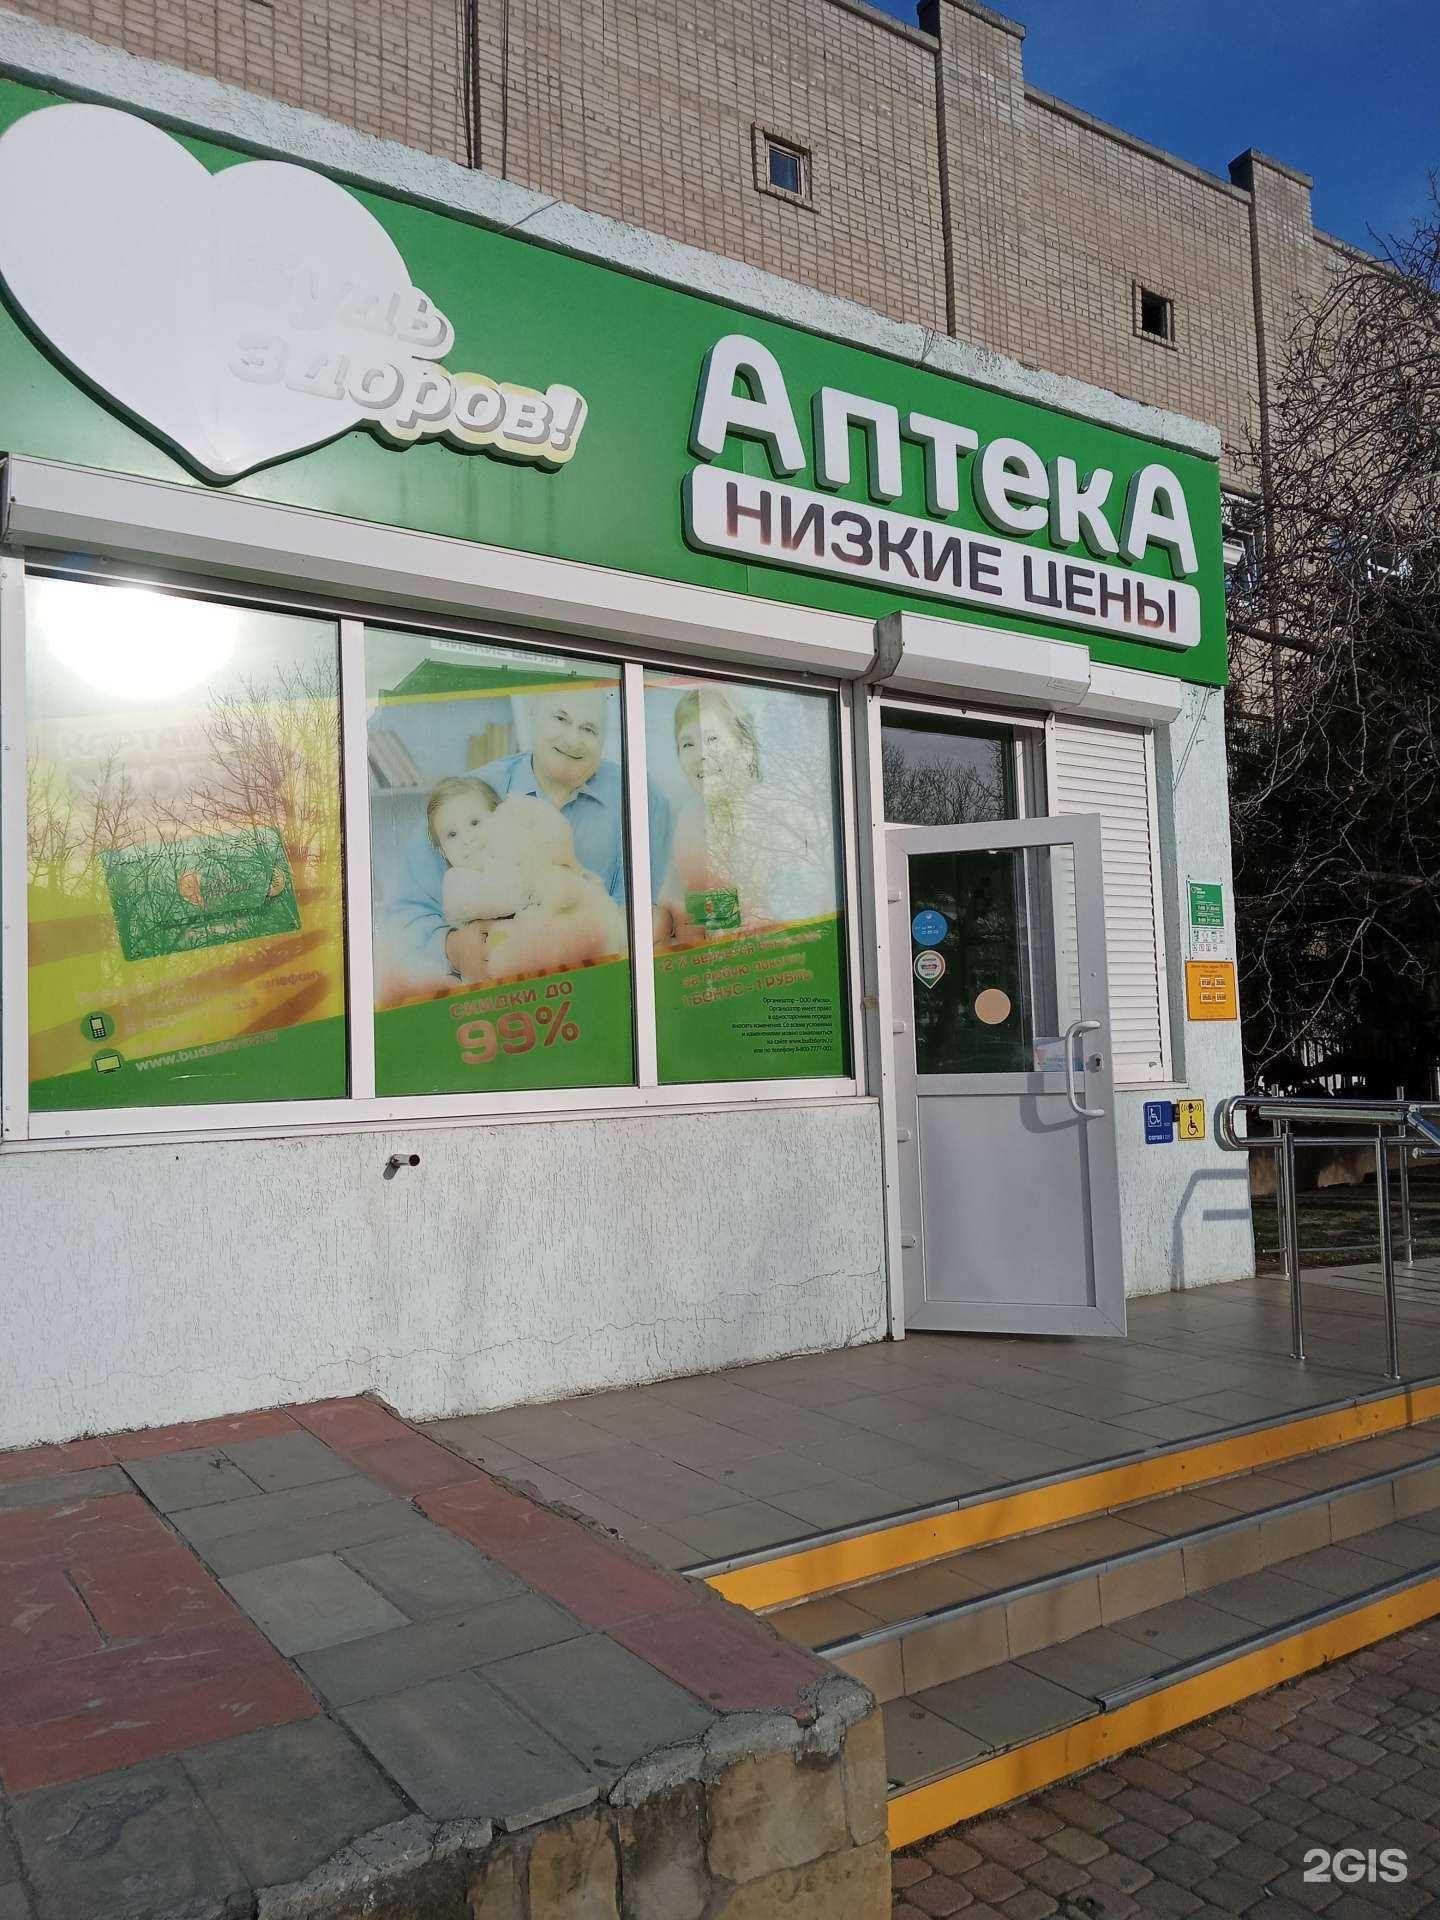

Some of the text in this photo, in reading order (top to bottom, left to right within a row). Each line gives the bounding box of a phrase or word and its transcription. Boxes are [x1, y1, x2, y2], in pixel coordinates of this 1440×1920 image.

[726, 481, 1177, 633] НИЗКИЕ ЦЕНЫ
[457, 1000, 580, 1064] 99%
